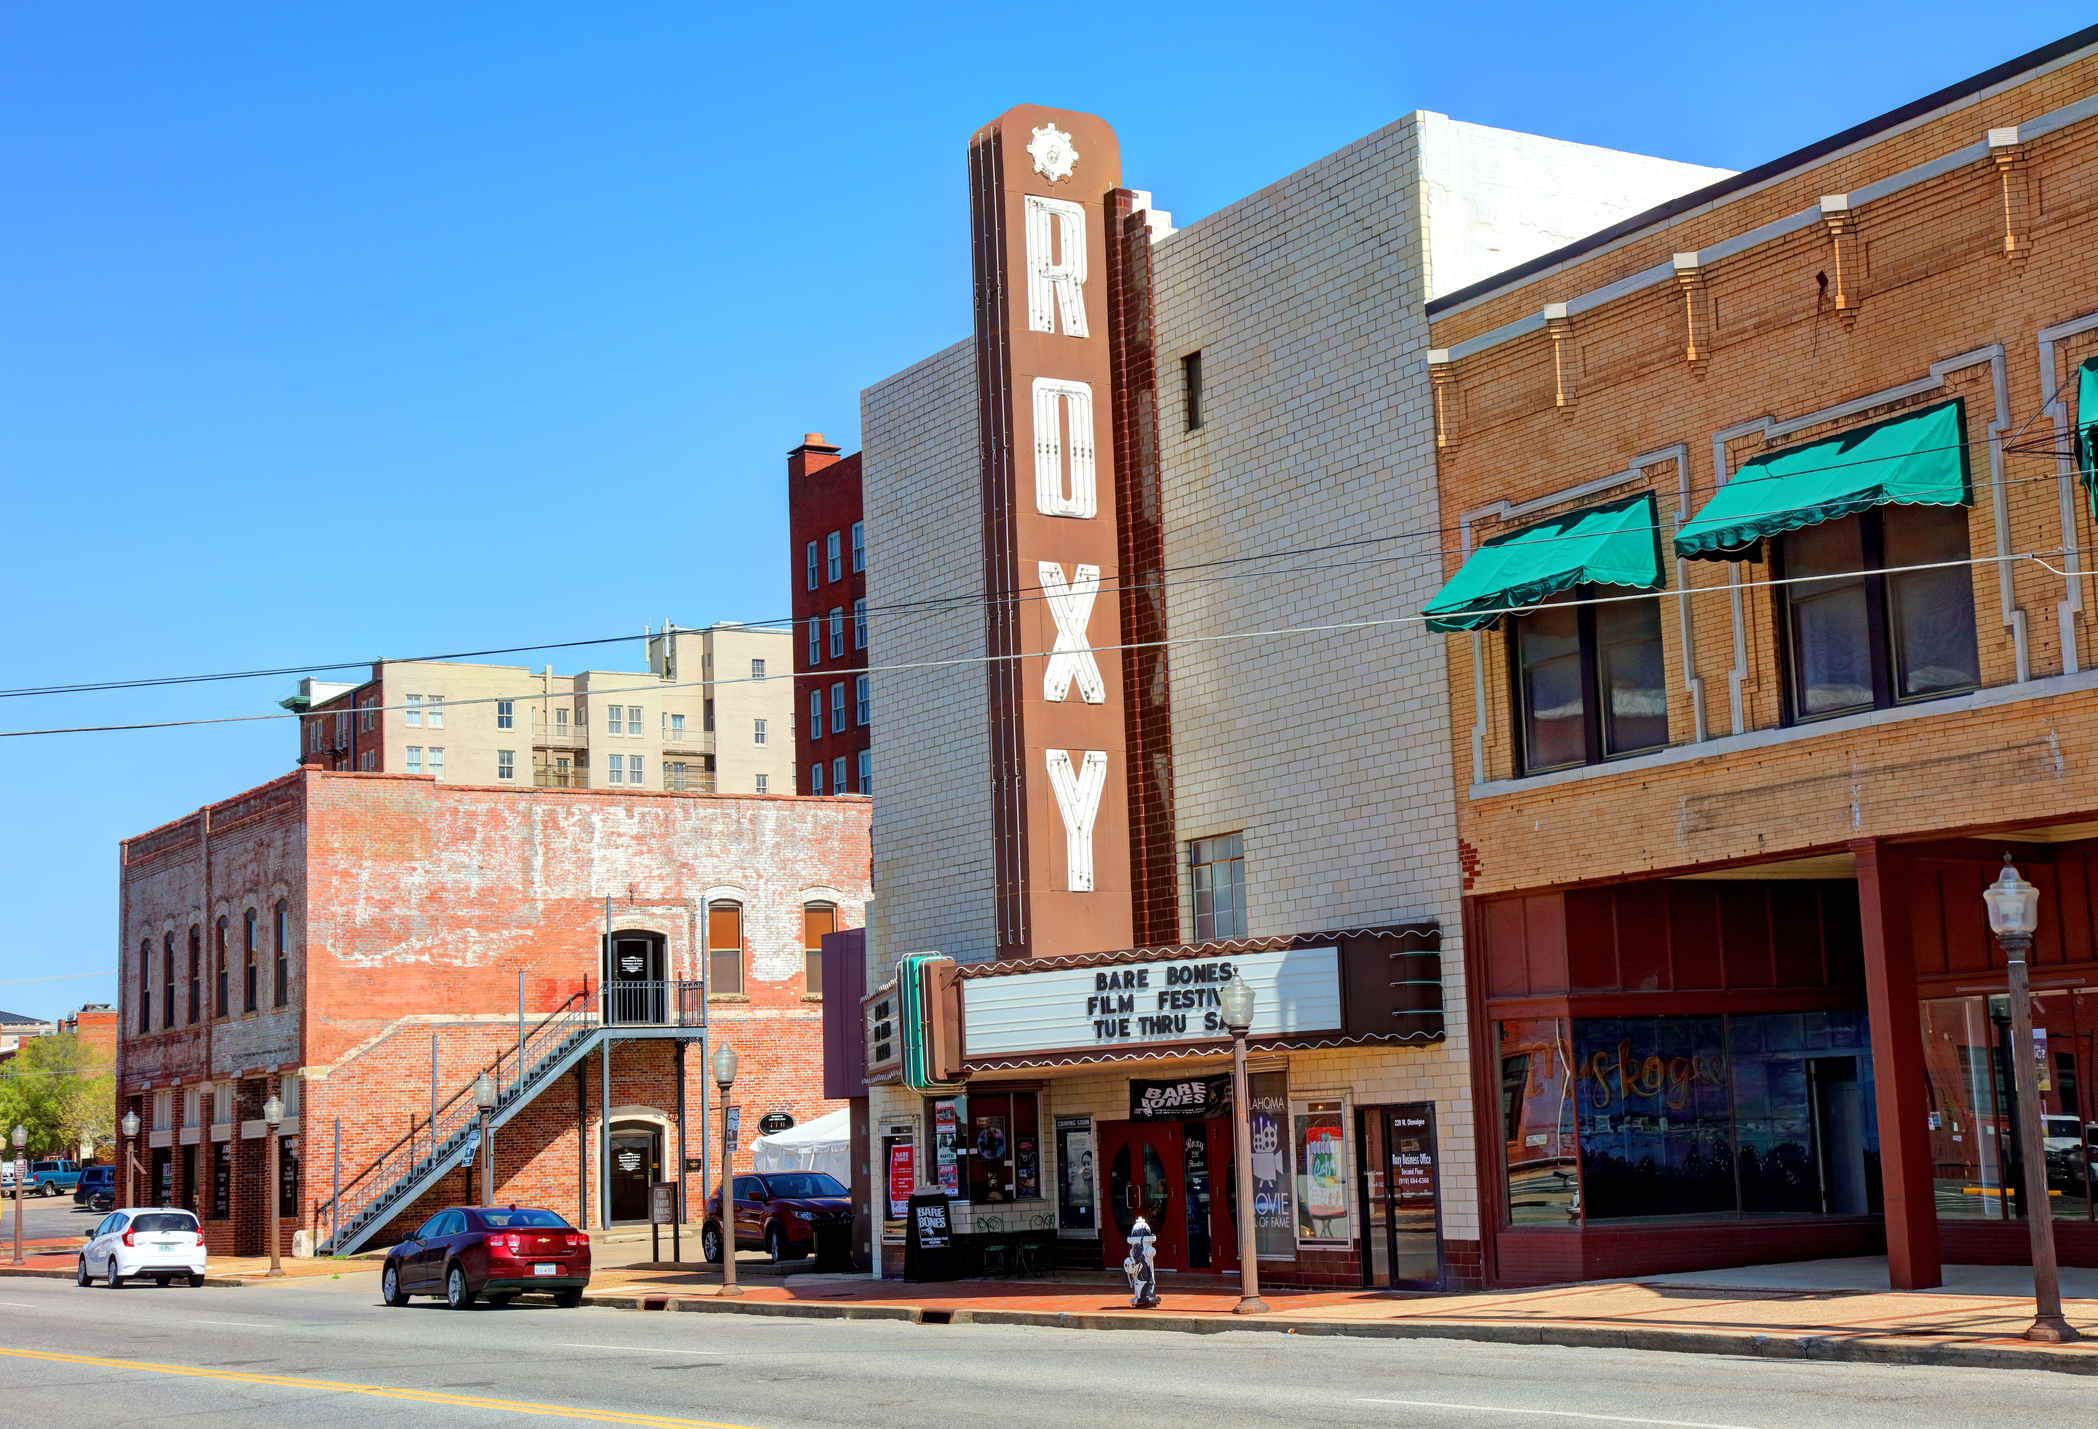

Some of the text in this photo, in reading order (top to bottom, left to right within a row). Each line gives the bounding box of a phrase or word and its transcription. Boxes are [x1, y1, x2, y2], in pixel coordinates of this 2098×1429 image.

[1024, 194, 1108, 892] ROXY
[1095, 962, 1233, 992] BARE BONES
[1087, 987, 1225, 1016] FILM FESTIV
[1093, 1011, 1228, 1039] TUE THRU SA
[1519, 1038, 1729, 1110] Muskogee
[1144, 1082, 1207, 1099] BARE
[1141, 1094, 1205, 1108] BONES
[1249, 1096, 1285, 1110] LAHOMA
[1407, 1118, 1425, 1127] Okmulgee
[1185, 1137, 1205, 1152] Roxy
[1402, 1153, 1420, 1165] Business
[1420, 1153, 1431, 1164] Office
[1414, 1167, 1424, 1175] Floor
[1398, 1177, 1409, 1186] (918)
[655, 1199, 670, 1207] 2 HOUR
[1254, 1192, 1290, 1215] OVIE
[917, 1207, 945, 1217] BARE
[918, 1216, 946, 1228] BONES
[1259, 1216, 1269, 1228] OF
[1271, 1216, 1290, 1228] FAME
